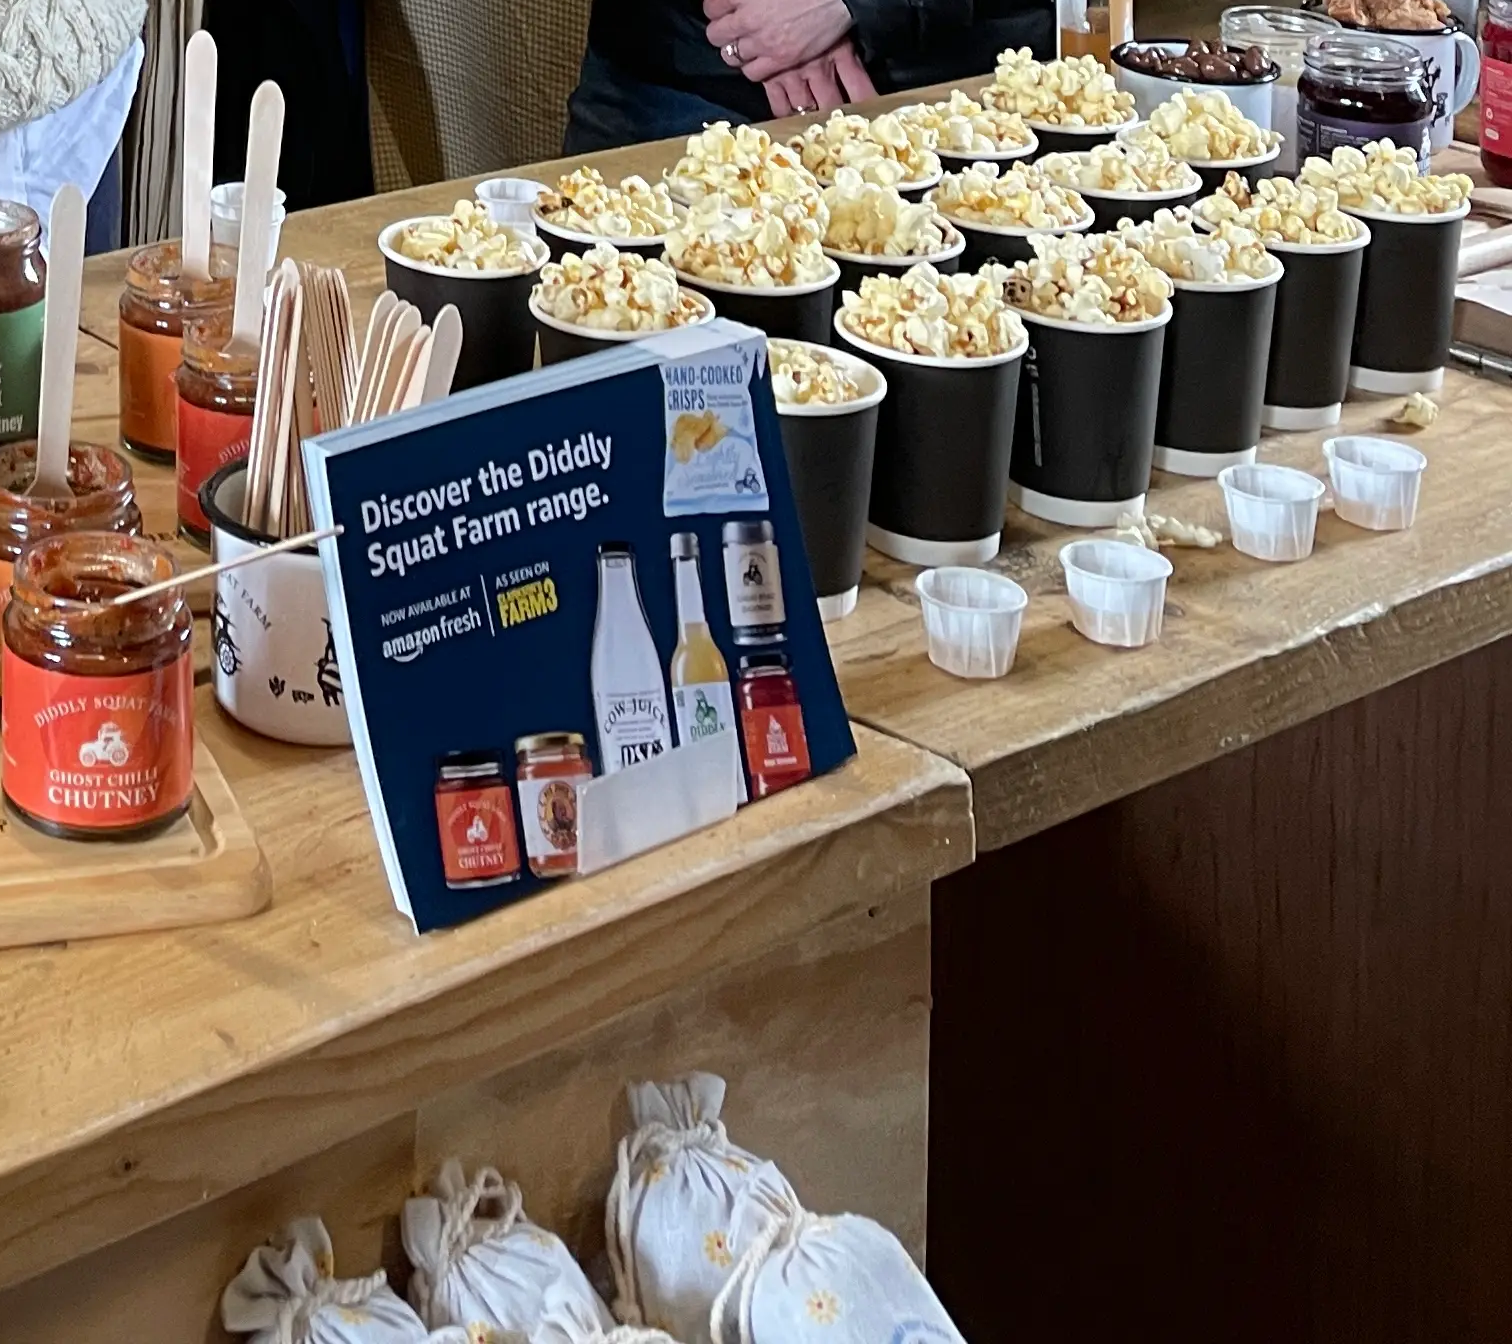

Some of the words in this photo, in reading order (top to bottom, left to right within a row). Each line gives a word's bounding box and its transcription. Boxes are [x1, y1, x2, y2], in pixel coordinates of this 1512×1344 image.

[664, 364, 744, 387] HAND-COOKED
[667, 387, 706, 411] CRISPS
[360, 476, 473, 535] Discover
[477, 460, 524, 498] the
[527, 431, 612, 482] Diddly
[366, 524, 449, 578] Squat
[451, 505, 522, 551] Farm
[525, 481, 610, 527] range.
[495, 575, 509, 590] AS
[509, 566, 534, 585] SEEN
[534, 560, 550, 577] ON
[240, 588, 273, 632] FARM
[380, 608, 406, 628] NOW
[407, 590, 459, 618] AVAILABLE
[459, 585, 472, 602] AT
[381, 623, 441, 660] amazon
[439, 606, 482, 640] fresh
[33, 696, 88, 729] DIDDLY
[93, 694, 145, 711] SQUAT
[603, 699, 626, 734] COW
[49, 768, 105, 788] GHOST
[107, 765, 159, 788] CHILLI
[47, 782, 160, 810] CHUTNEY
[458, 852, 505, 870] CHUTNEY
